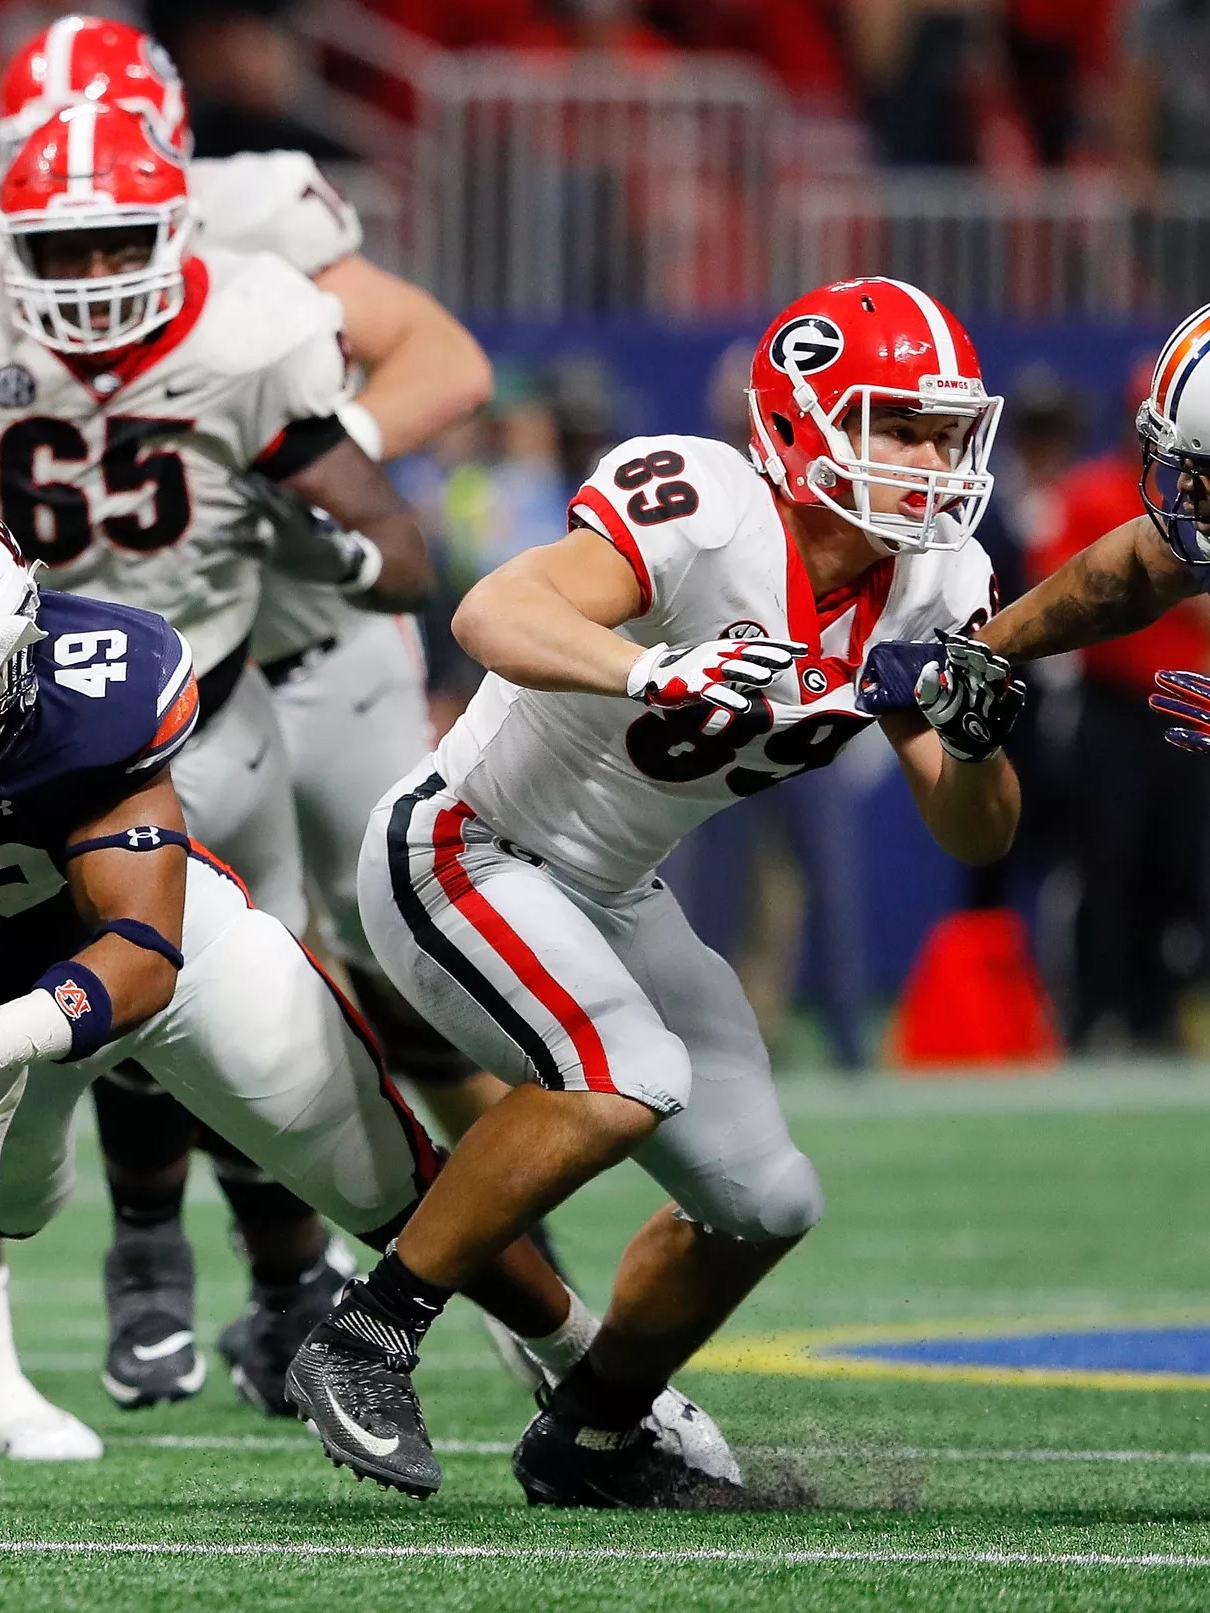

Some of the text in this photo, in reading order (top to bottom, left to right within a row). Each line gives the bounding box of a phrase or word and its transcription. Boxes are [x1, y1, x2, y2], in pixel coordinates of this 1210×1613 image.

[769, 314, 845, 376] G
[937, 380, 968, 390] DAWGS
[613, 450, 700, 527] 89
[54, 629, 128, 699] 49
[802, 668, 828, 694] G
